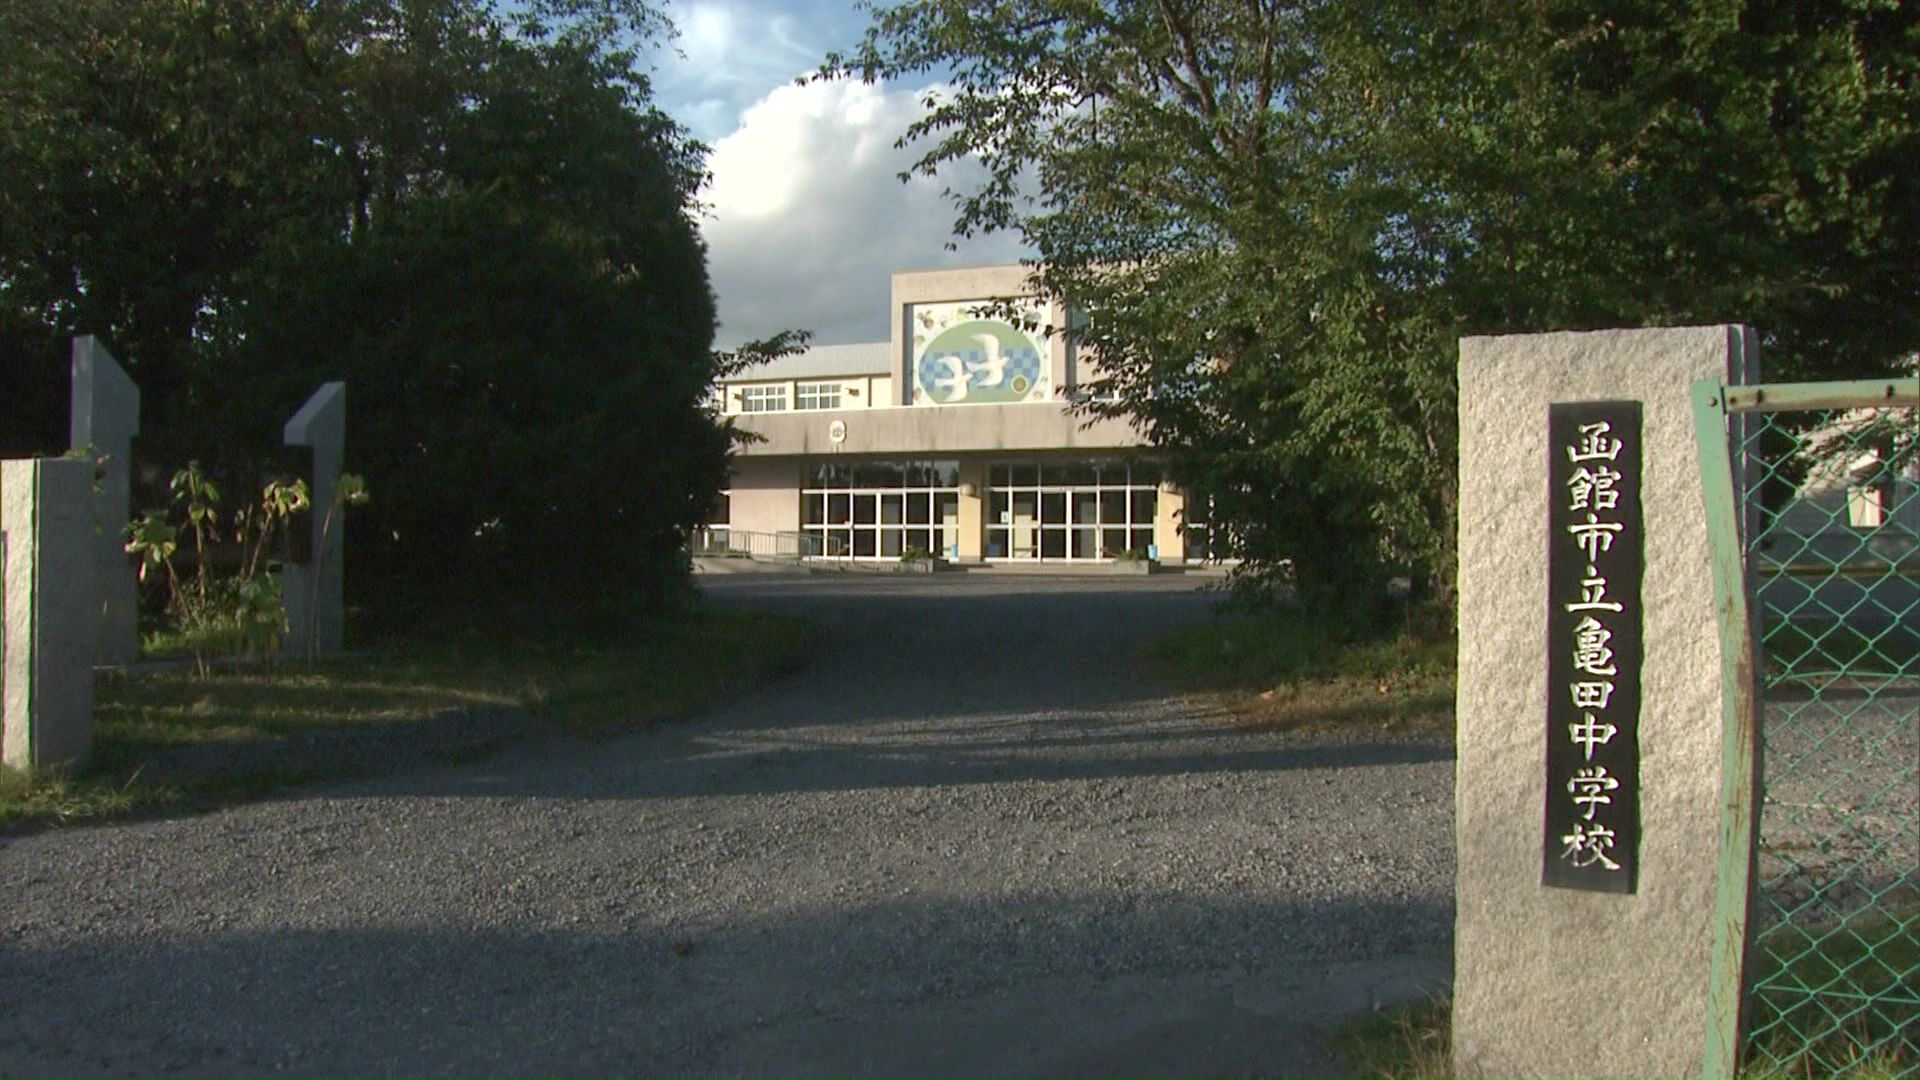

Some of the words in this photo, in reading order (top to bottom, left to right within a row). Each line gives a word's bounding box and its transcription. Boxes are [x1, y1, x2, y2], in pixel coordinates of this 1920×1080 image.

[1561, 420, 1623, 870] 函館市立亀田中学校
